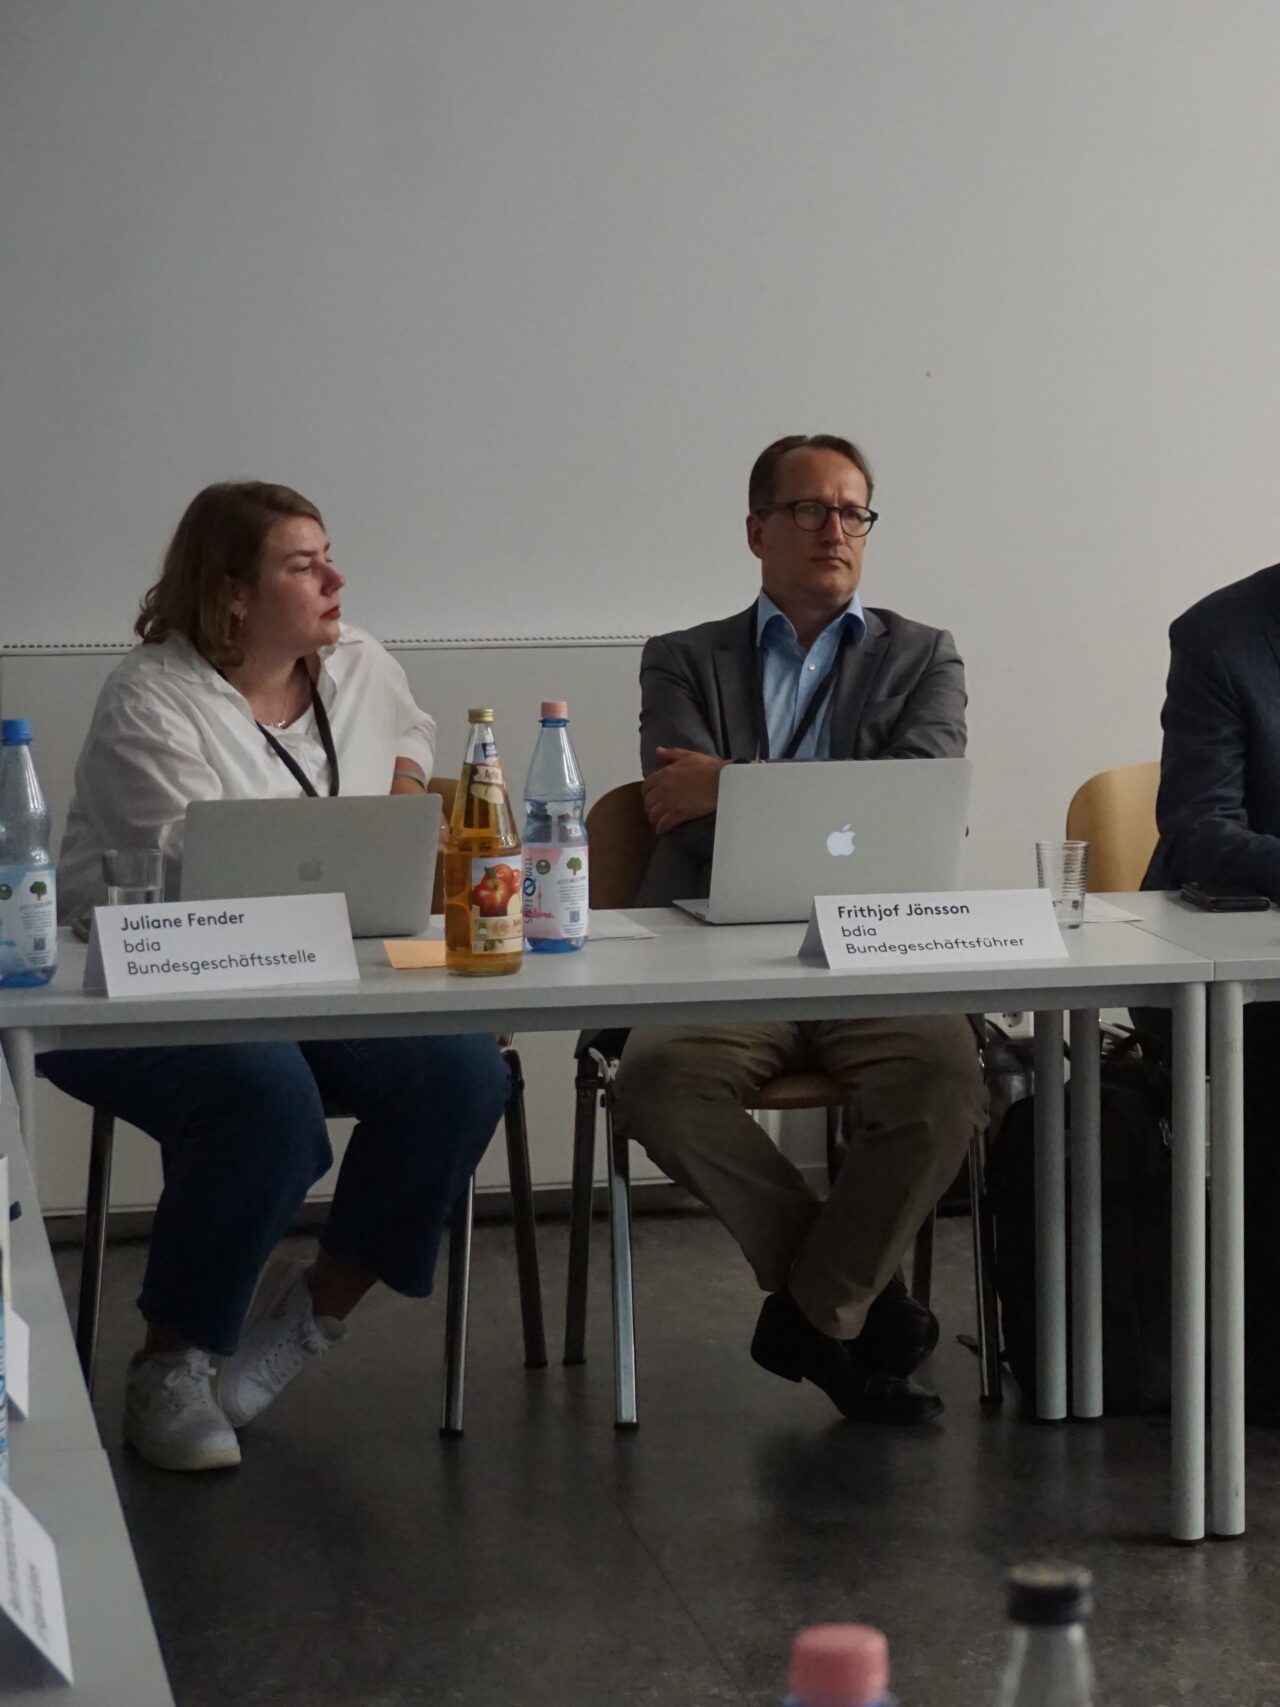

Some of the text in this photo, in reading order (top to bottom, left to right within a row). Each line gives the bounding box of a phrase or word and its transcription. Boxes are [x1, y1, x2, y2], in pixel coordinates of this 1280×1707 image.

[837, 903, 971, 921] Frithjof Jönsson
[121, 911, 246, 932] Juliane Fender
[841, 925, 877, 938] bdia
[123, 938, 161, 954] bdia
[846, 936, 1025, 955] Bundegeschäftsführer
[127, 949, 317, 976] Bundesgeschäftsstelle
